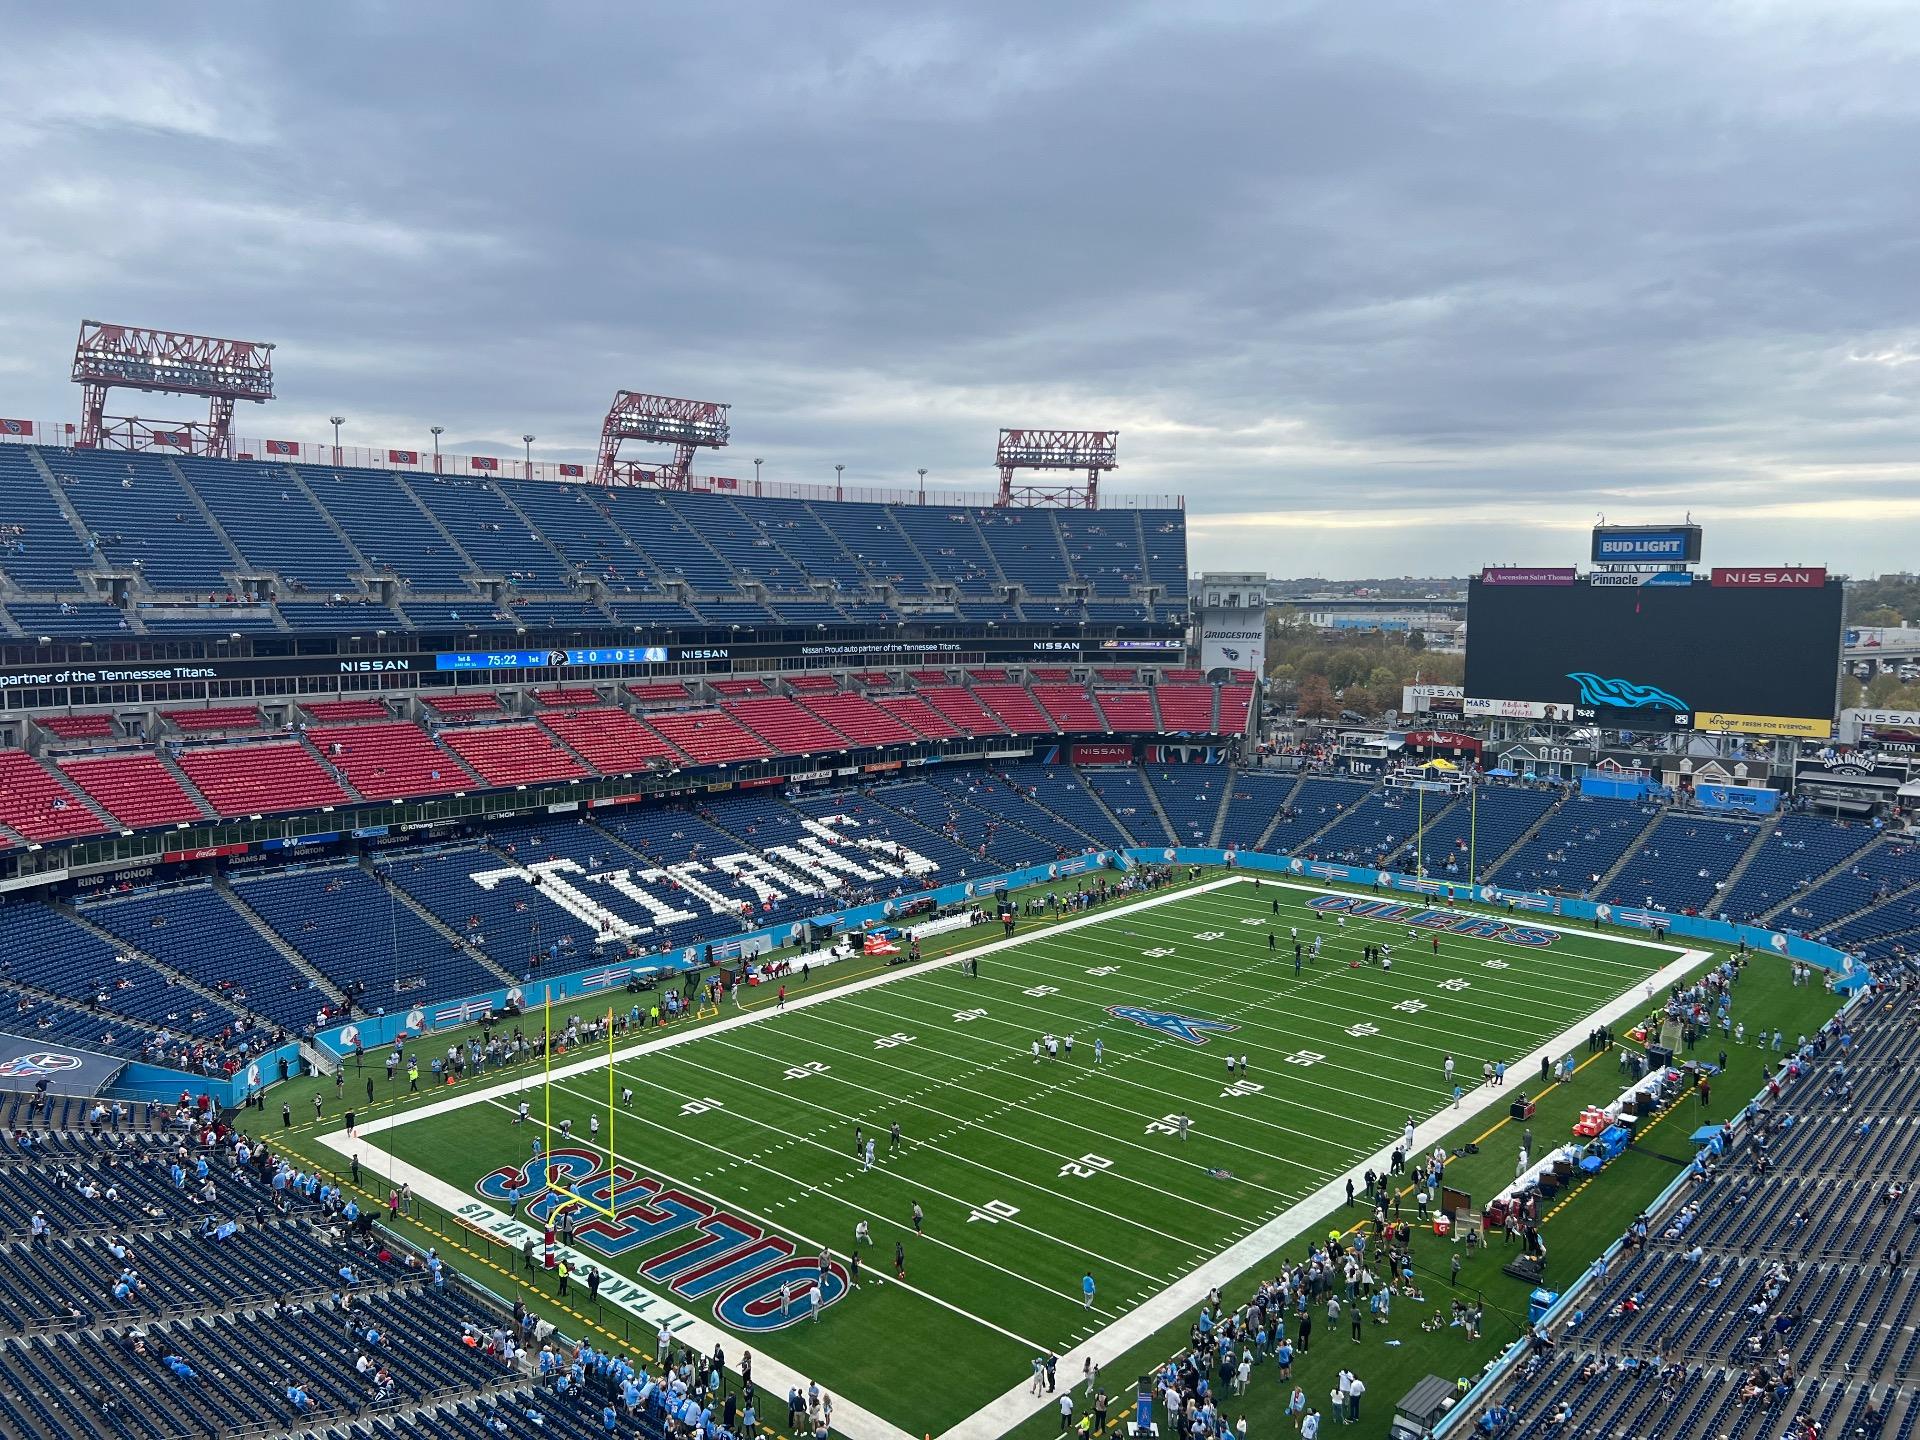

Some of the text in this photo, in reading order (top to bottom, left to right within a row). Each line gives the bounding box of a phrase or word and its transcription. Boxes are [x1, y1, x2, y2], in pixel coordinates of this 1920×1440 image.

[1603, 541, 1680, 552] BUD LIGHT
[1592, 574, 1638, 585] Pinnacle
[1726, 573, 1810, 583] NISSAN
[1203, 630, 1263, 640] BRIDGESTONE
[824, 646, 843, 654] Proud
[844, 645, 858, 653] auto
[858, 644, 883, 654] partner
[883, 643, 891, 652] of
[890, 643, 903, 651] the
[902, 643, 938, 651] Tennessee
[1033, 641, 1080, 650] NISSAN
[487, 654, 517, 666] 75:22
[589, 651, 597, 661] 0
[615, 651, 622, 661] 0
[681, 649, 728, 659] NISSAN
[340, 659, 409, 672] NISSAN
[0, 667, 217, 688] partner of the Tennessee Titans.
[1412, 688, 1465, 698] NISSAN
[1466, 699, 1491, 708] MARS
[1434, 712, 1459, 721] TITAN
[1709, 714, 1739, 730] Kroger
[1855, 713, 1920, 725] NISSA
[1080, 747, 1125, 756] NISSAN
[1882, 743, 1916, 752] TITAN
[1823, 754, 1844, 769] JACK
[376, 835, 410, 845] HOUSTON
[293, 846, 325, 857] NORTON
[228, 853, 267, 866] ADAMS JR
[114, 867, 154, 882] HONOR
[77, 875, 105, 889] RING
[1304, 895, 1561, 947] OILERS
[1022, 984, 1061, 998] 50
[952, 1007, 989, 1022] 40
[872, 1031, 918, 1050] 30
[1284, 1049, 1327, 1067] 50
[782, 1060, 832, 1081] 20
[1225, 1079, 1266, 1098] 40
[680, 1096, 725, 1116] 10
[1146, 1113, 1196, 1136] 30
[1060, 1152, 1115, 1179] 20
[457, 1203, 495, 1222] US
[969, 1199, 1021, 1224] 10
[489, 1221, 528, 1239] OF
[1438, 1224, 1446, 1232] G
[474, 1147, 852, 1332] OILERS
[655, 1312, 696, 1333] IT
